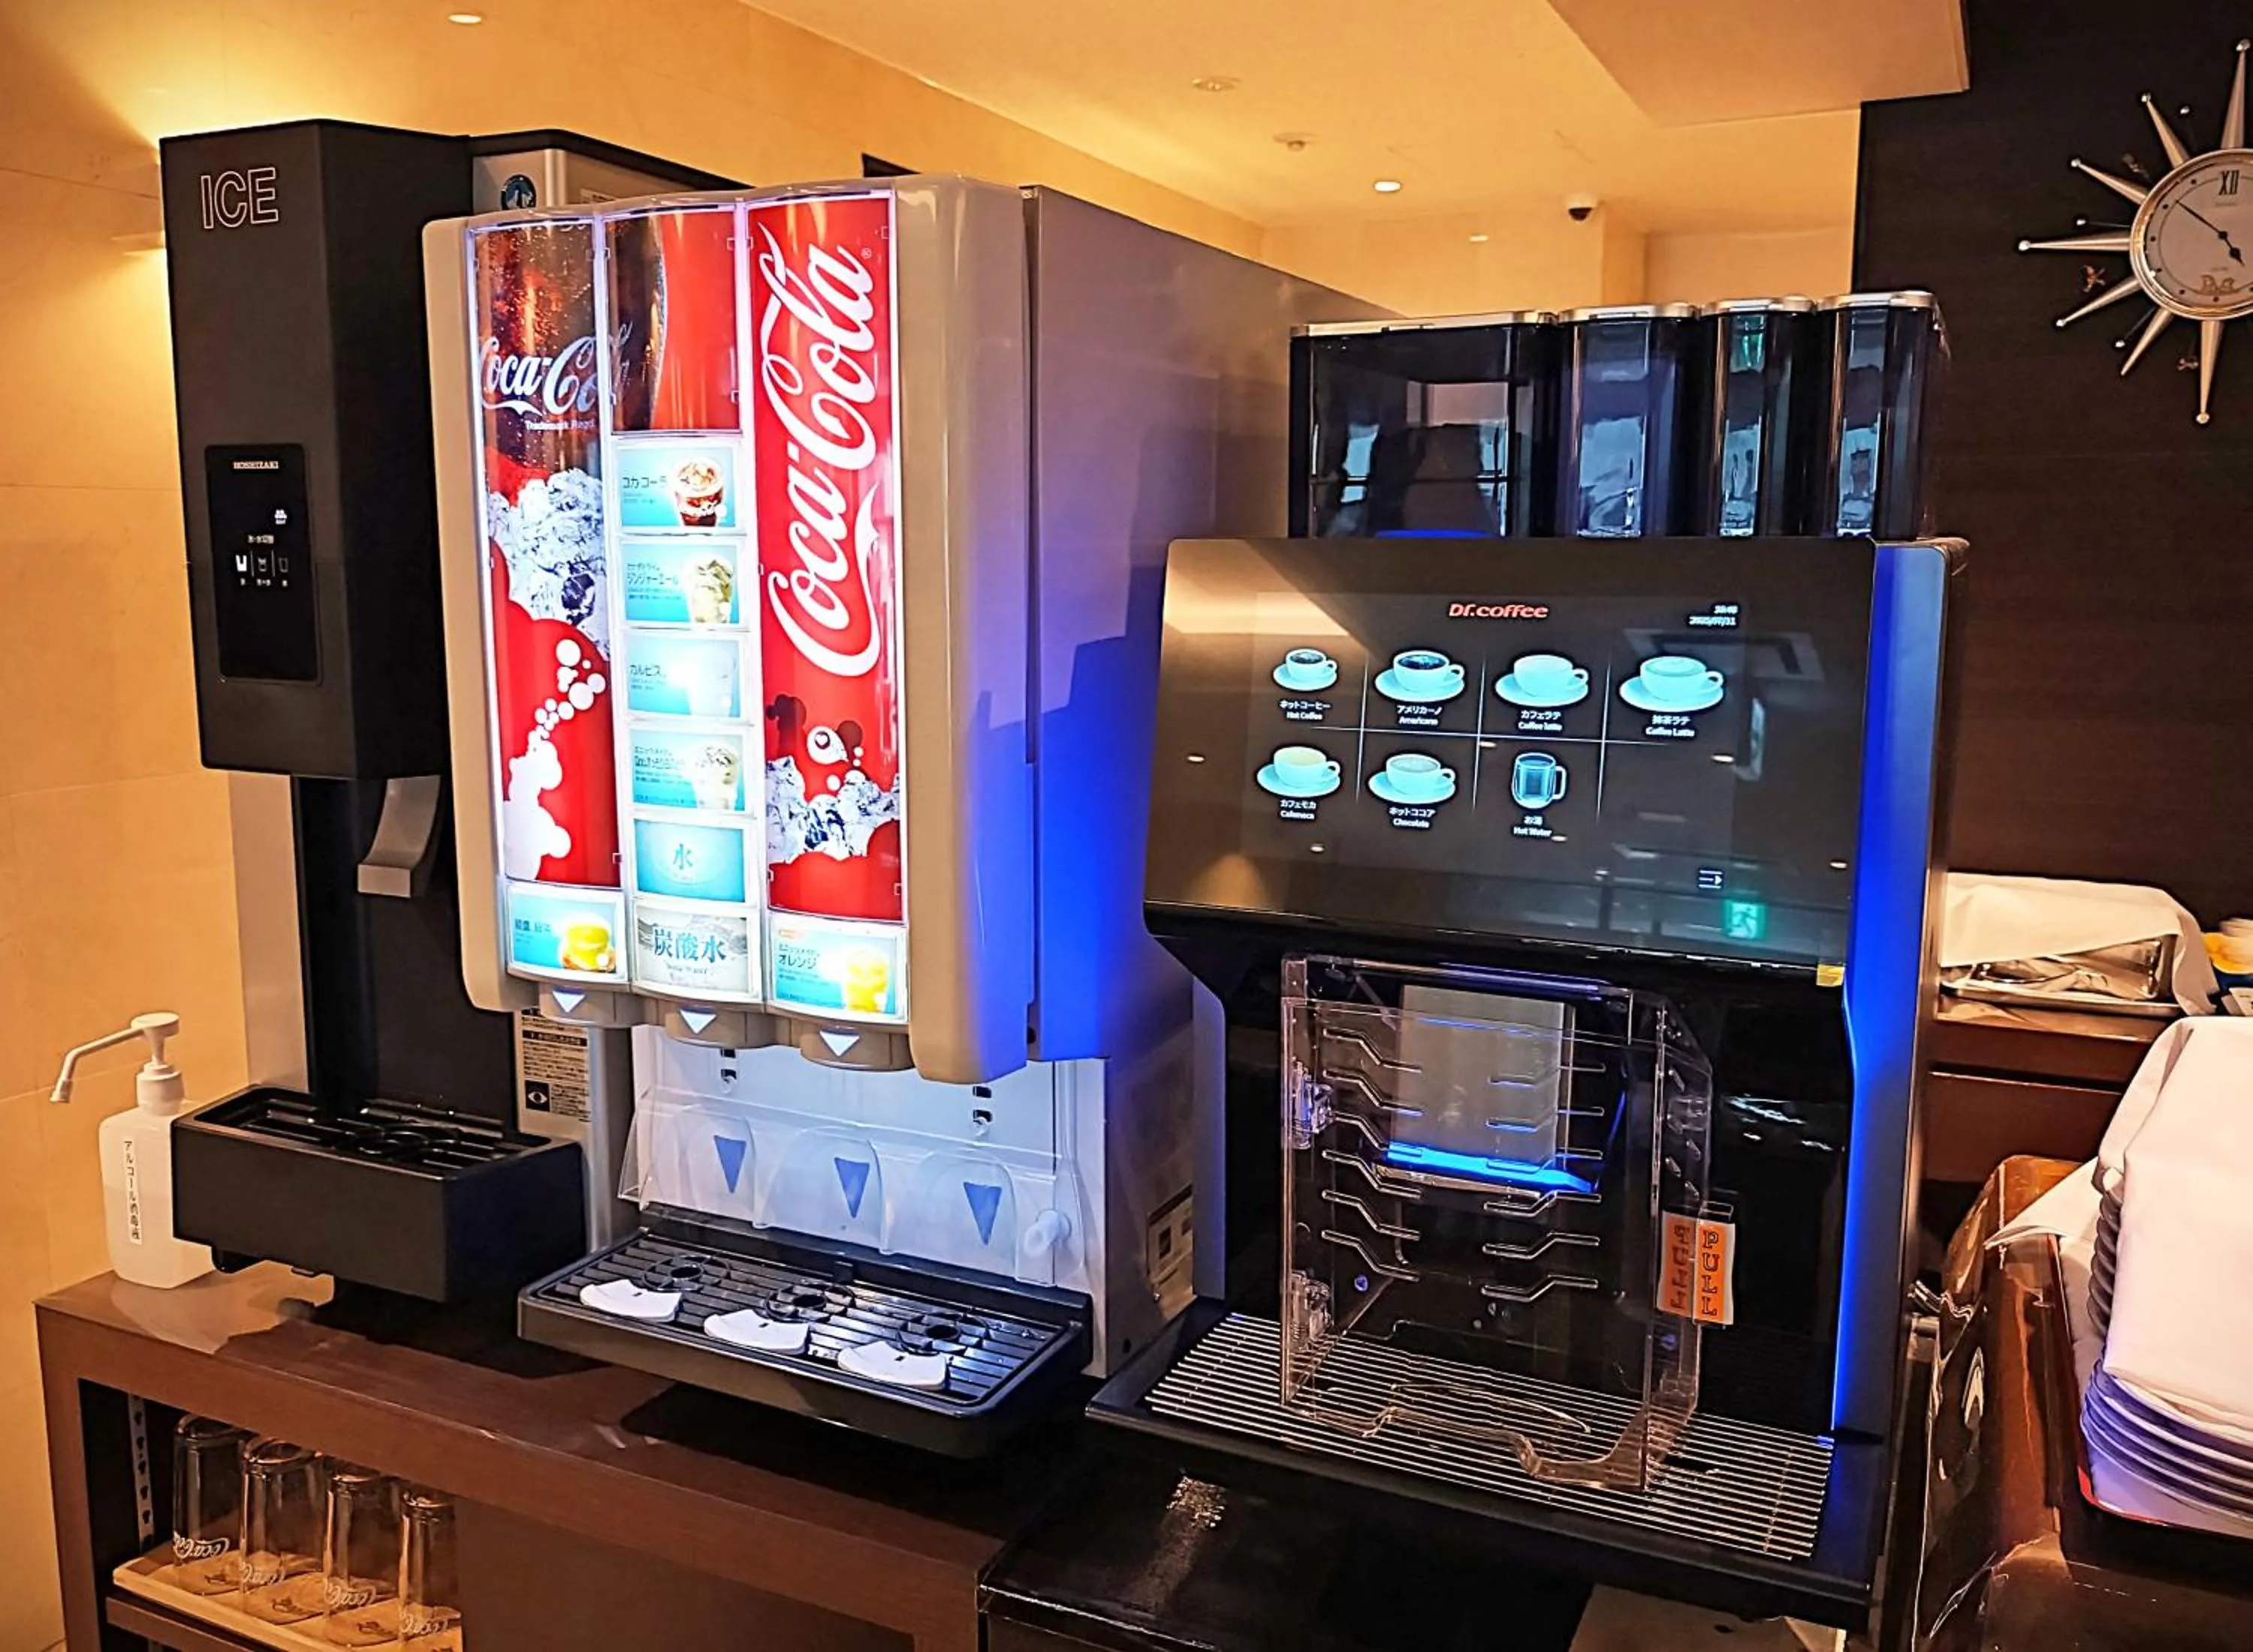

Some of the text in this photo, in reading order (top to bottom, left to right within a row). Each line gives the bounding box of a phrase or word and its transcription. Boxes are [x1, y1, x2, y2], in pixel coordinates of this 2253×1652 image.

[2218, 169, 2239, 196] XII
[200, 167, 279, 229] ICE
[757, 222, 882, 678] Coca-Cola
[1449, 603, 1549, 618] Dr.coffee
[1280, 700, 1331, 710] ホットコーヒー
[1397, 705, 1442, 715] アメリカーノ
[1300, 712, 1323, 720] Coffee
[1521, 710, 1561, 720] カフェラテ
[1398, 716, 1438, 725] Americano
[1518, 722, 1543, 730] Coffee
[1645, 726, 1672, 736] Coffee
[1280, 800, 1317, 809] カフェモカ
[1389, 807, 1435, 817] ホットココア
[1393, 818, 1429, 828] Chocolate
[1513, 827, 1552, 837] Hot Water
[673, 843, 693, 870] 水
[654, 927, 727, 963] 炭酸水
[778, 954, 817, 969] オレンジ
[1701, 1228, 1719, 1316] PULL
